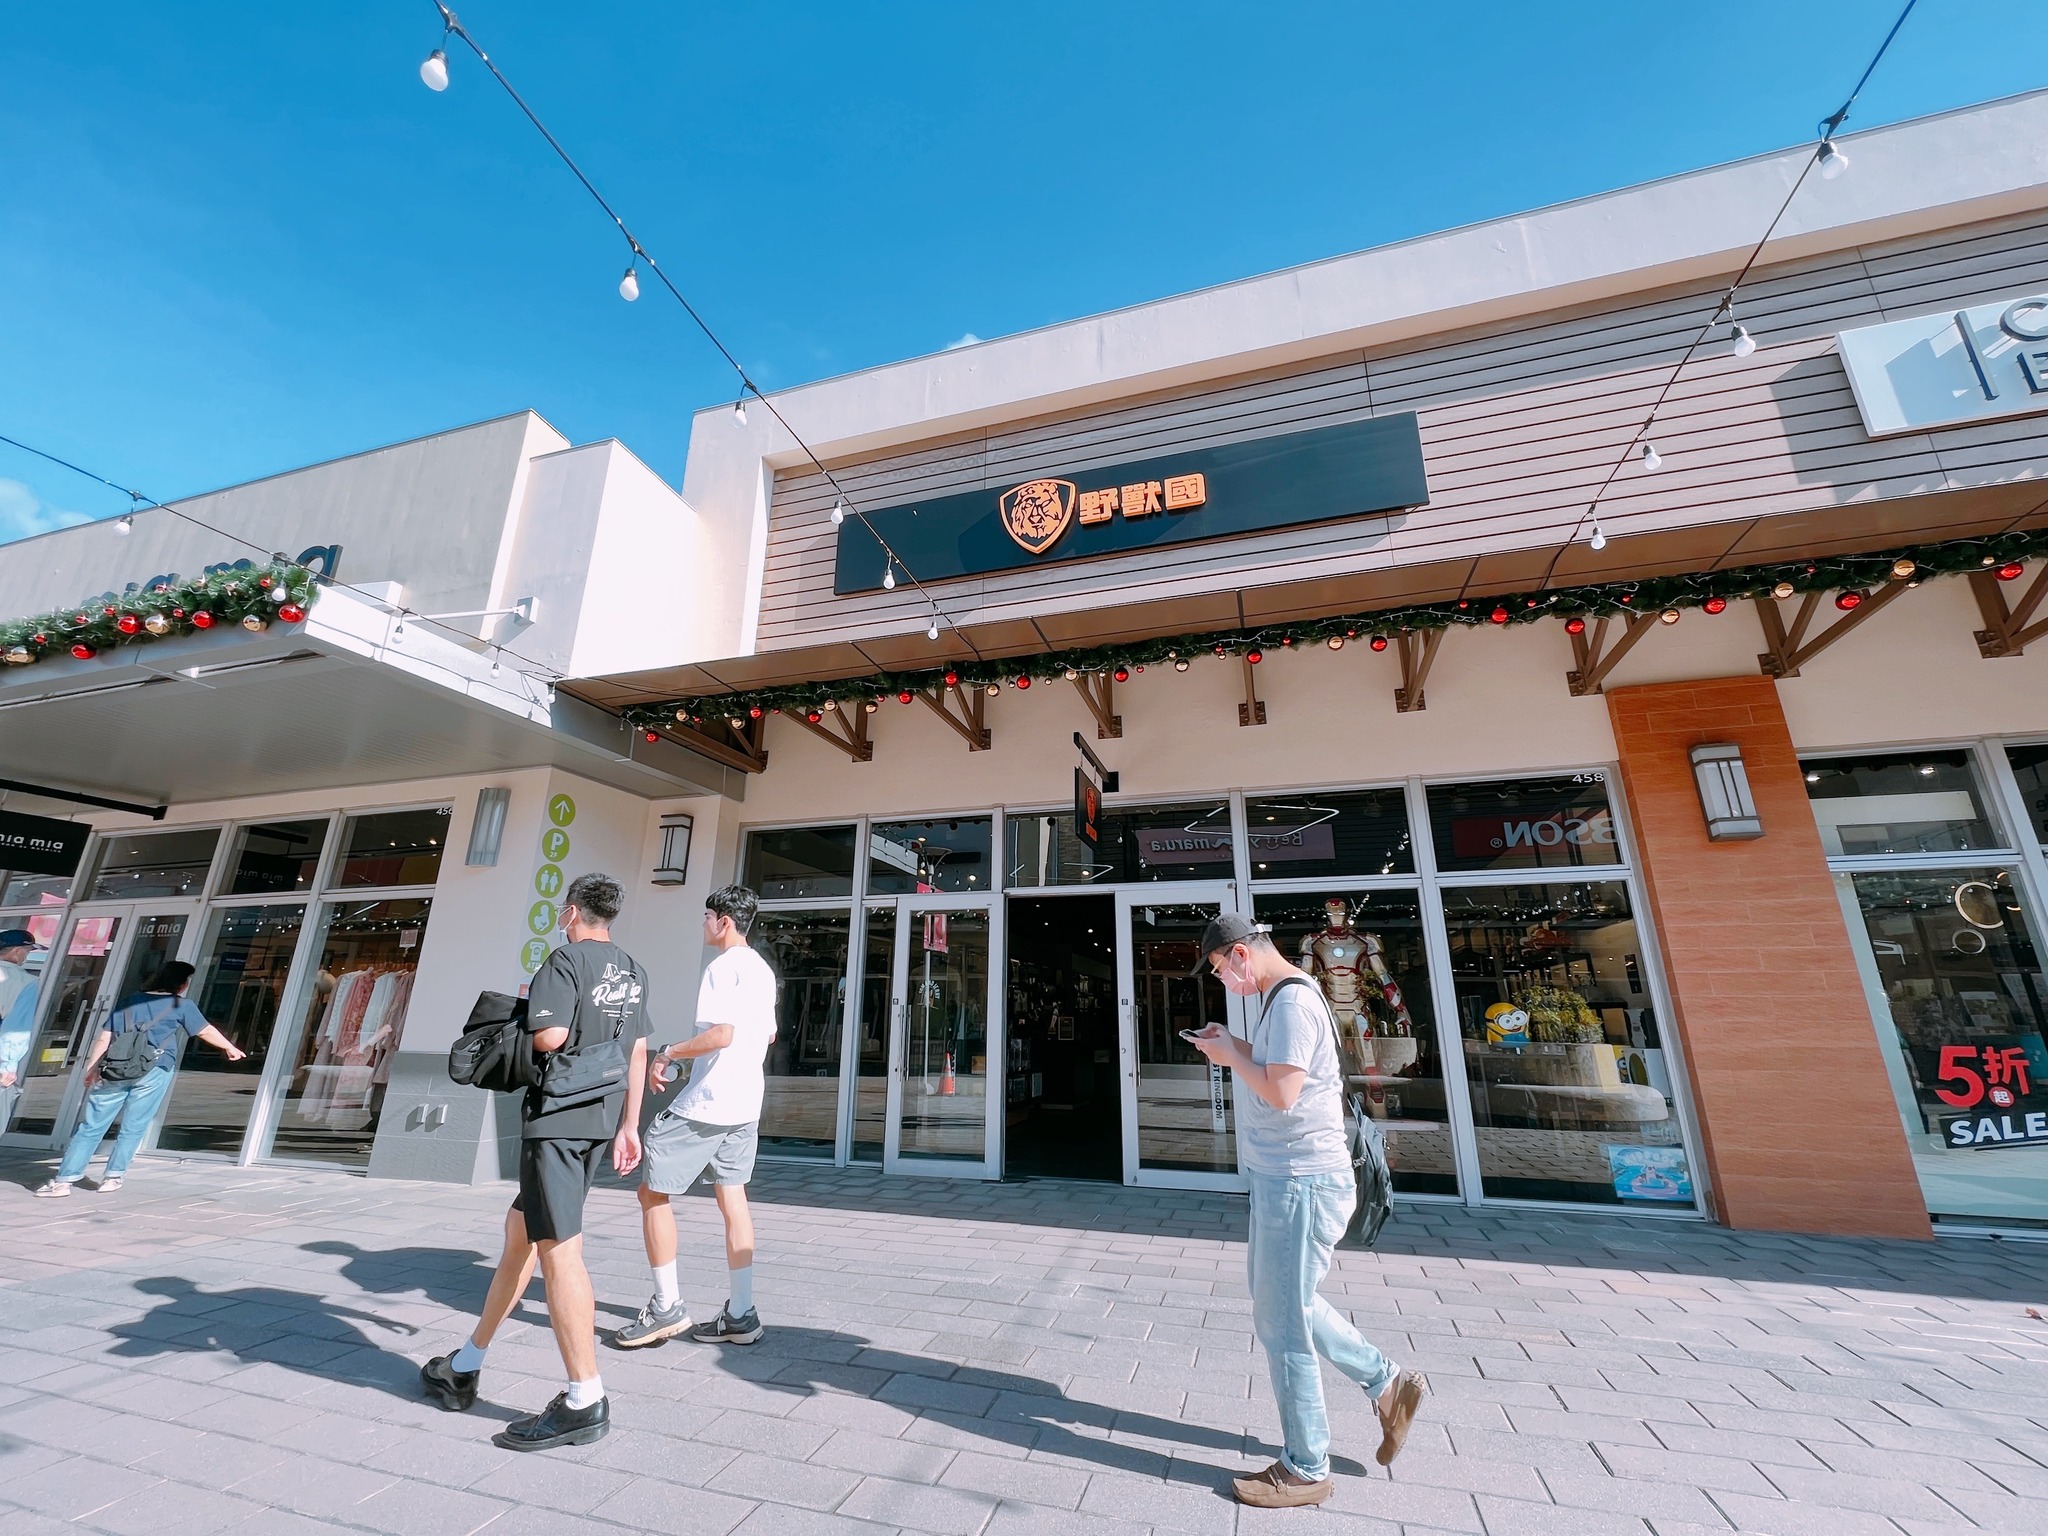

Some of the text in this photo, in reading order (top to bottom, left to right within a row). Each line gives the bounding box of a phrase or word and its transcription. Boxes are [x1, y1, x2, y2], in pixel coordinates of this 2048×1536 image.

[1078, 472, 1207, 525] 野獸國
[1572, 772, 1604, 783] 458
[29, 838, 64, 850] mia
[551, 832, 564, 850] P
[157, 922, 181, 934] mia
[1992, 1090, 2011, 1104] 起
[1949, 1112, 2048, 1145] SALE
